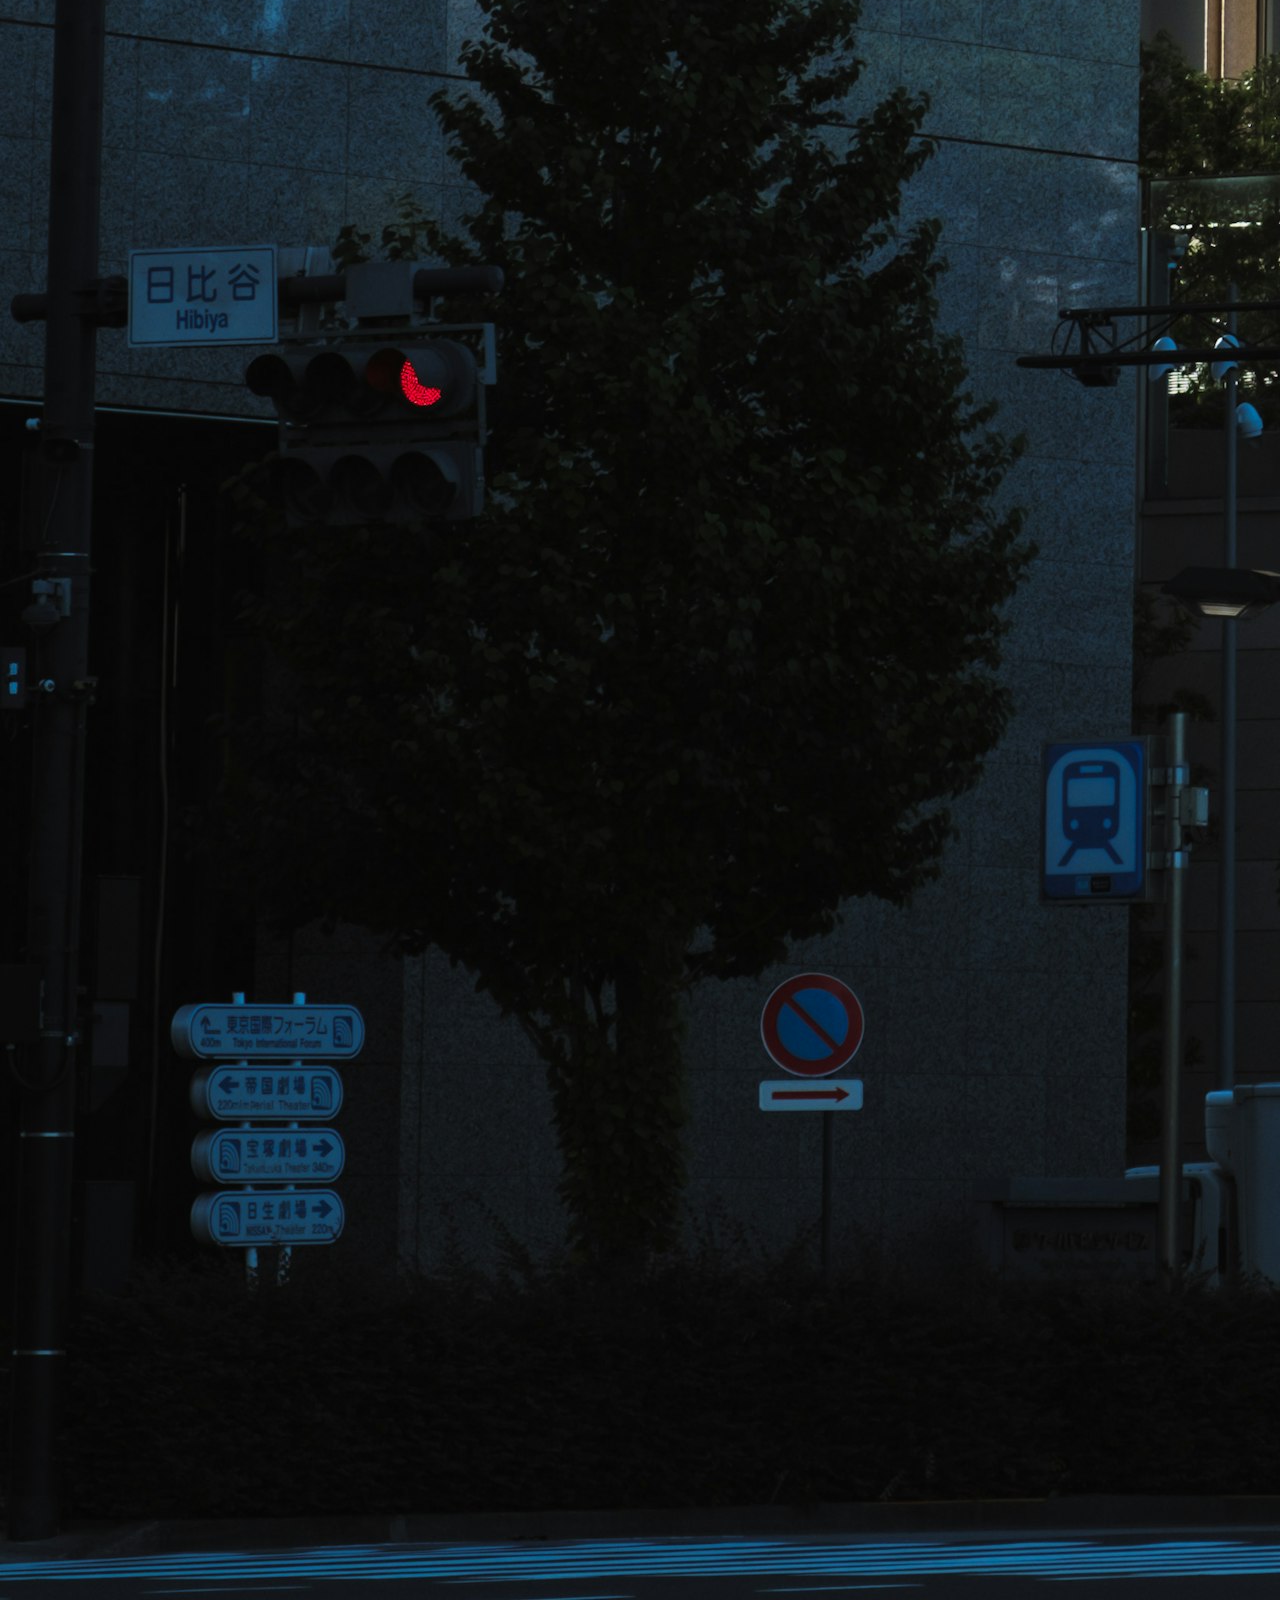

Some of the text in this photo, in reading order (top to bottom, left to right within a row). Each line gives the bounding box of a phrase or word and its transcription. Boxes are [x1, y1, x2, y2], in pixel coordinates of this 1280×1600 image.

[147, 263, 260, 304] 日比谷
[176, 309, 229, 333] Hibiya
[226, 1015, 328, 1035] 東京国際フォーラム
[200, 1037, 222, 1048] 400m
[233, 1037, 322, 1049] Tokyo International Forum
[245, 1075, 306, 1095] 帝国劇場
[279, 1100, 311, 1110] Theater
[246, 1138, 307, 1158] 宝塚劇場
[247, 1200, 307, 1220] 日生劇場
